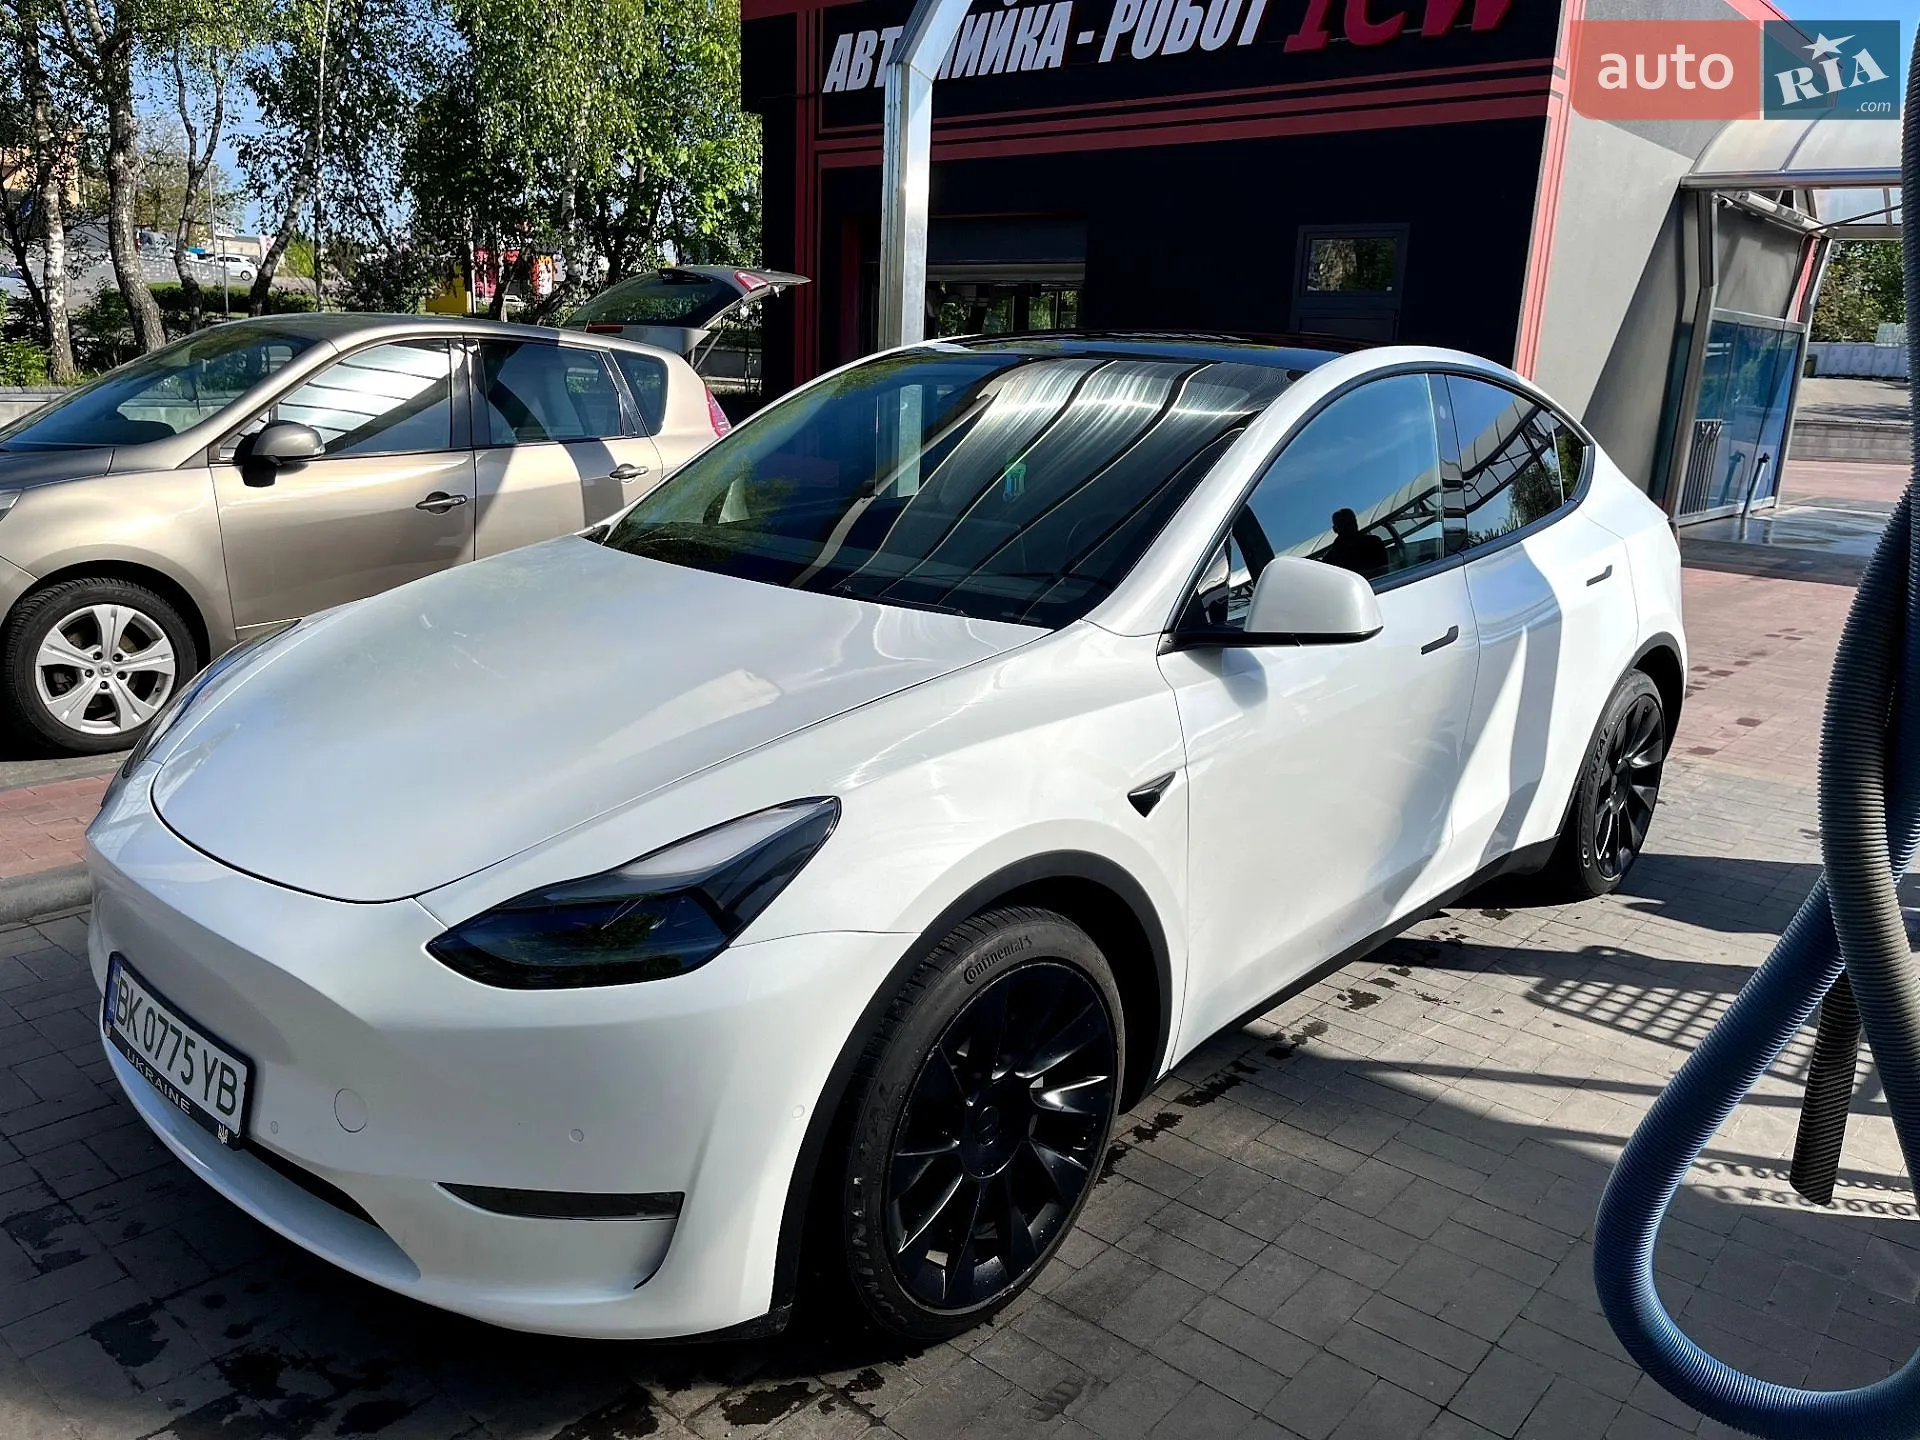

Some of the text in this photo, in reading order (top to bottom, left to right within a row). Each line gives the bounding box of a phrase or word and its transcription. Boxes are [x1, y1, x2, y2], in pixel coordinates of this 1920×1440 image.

[823, 0, 1073, 93] АВТИЙКА
[116, 978, 238, 1117] BK 0775 YB
[125, 1047, 192, 1116] UKRAINE
